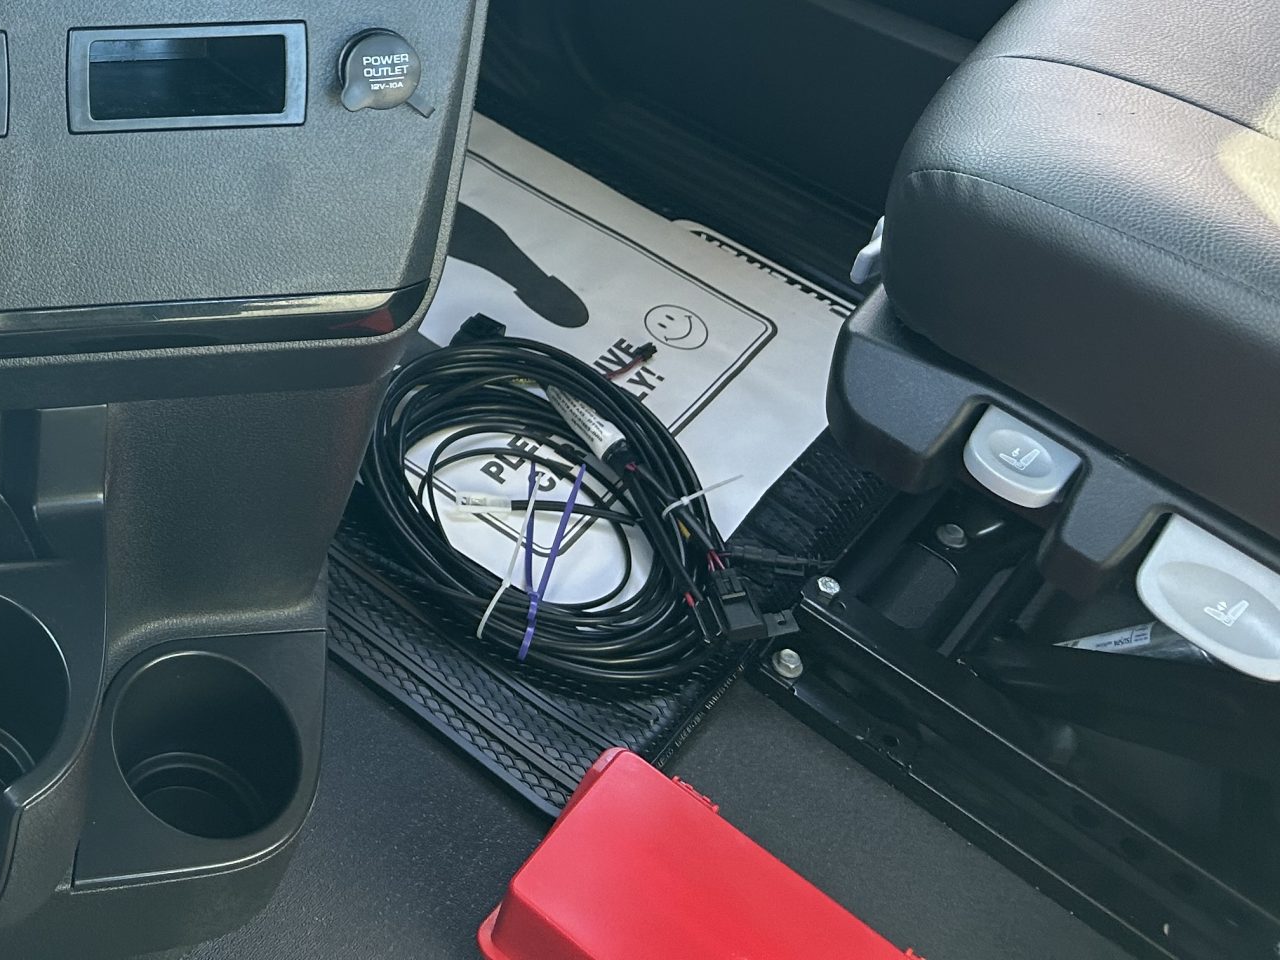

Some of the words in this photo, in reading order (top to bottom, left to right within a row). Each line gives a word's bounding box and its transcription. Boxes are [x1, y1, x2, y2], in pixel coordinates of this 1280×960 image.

[363, 53, 409, 65] POWER
[363, 65, 409, 77] OUTLET
[371, 81, 403, 90] 12V-10A
